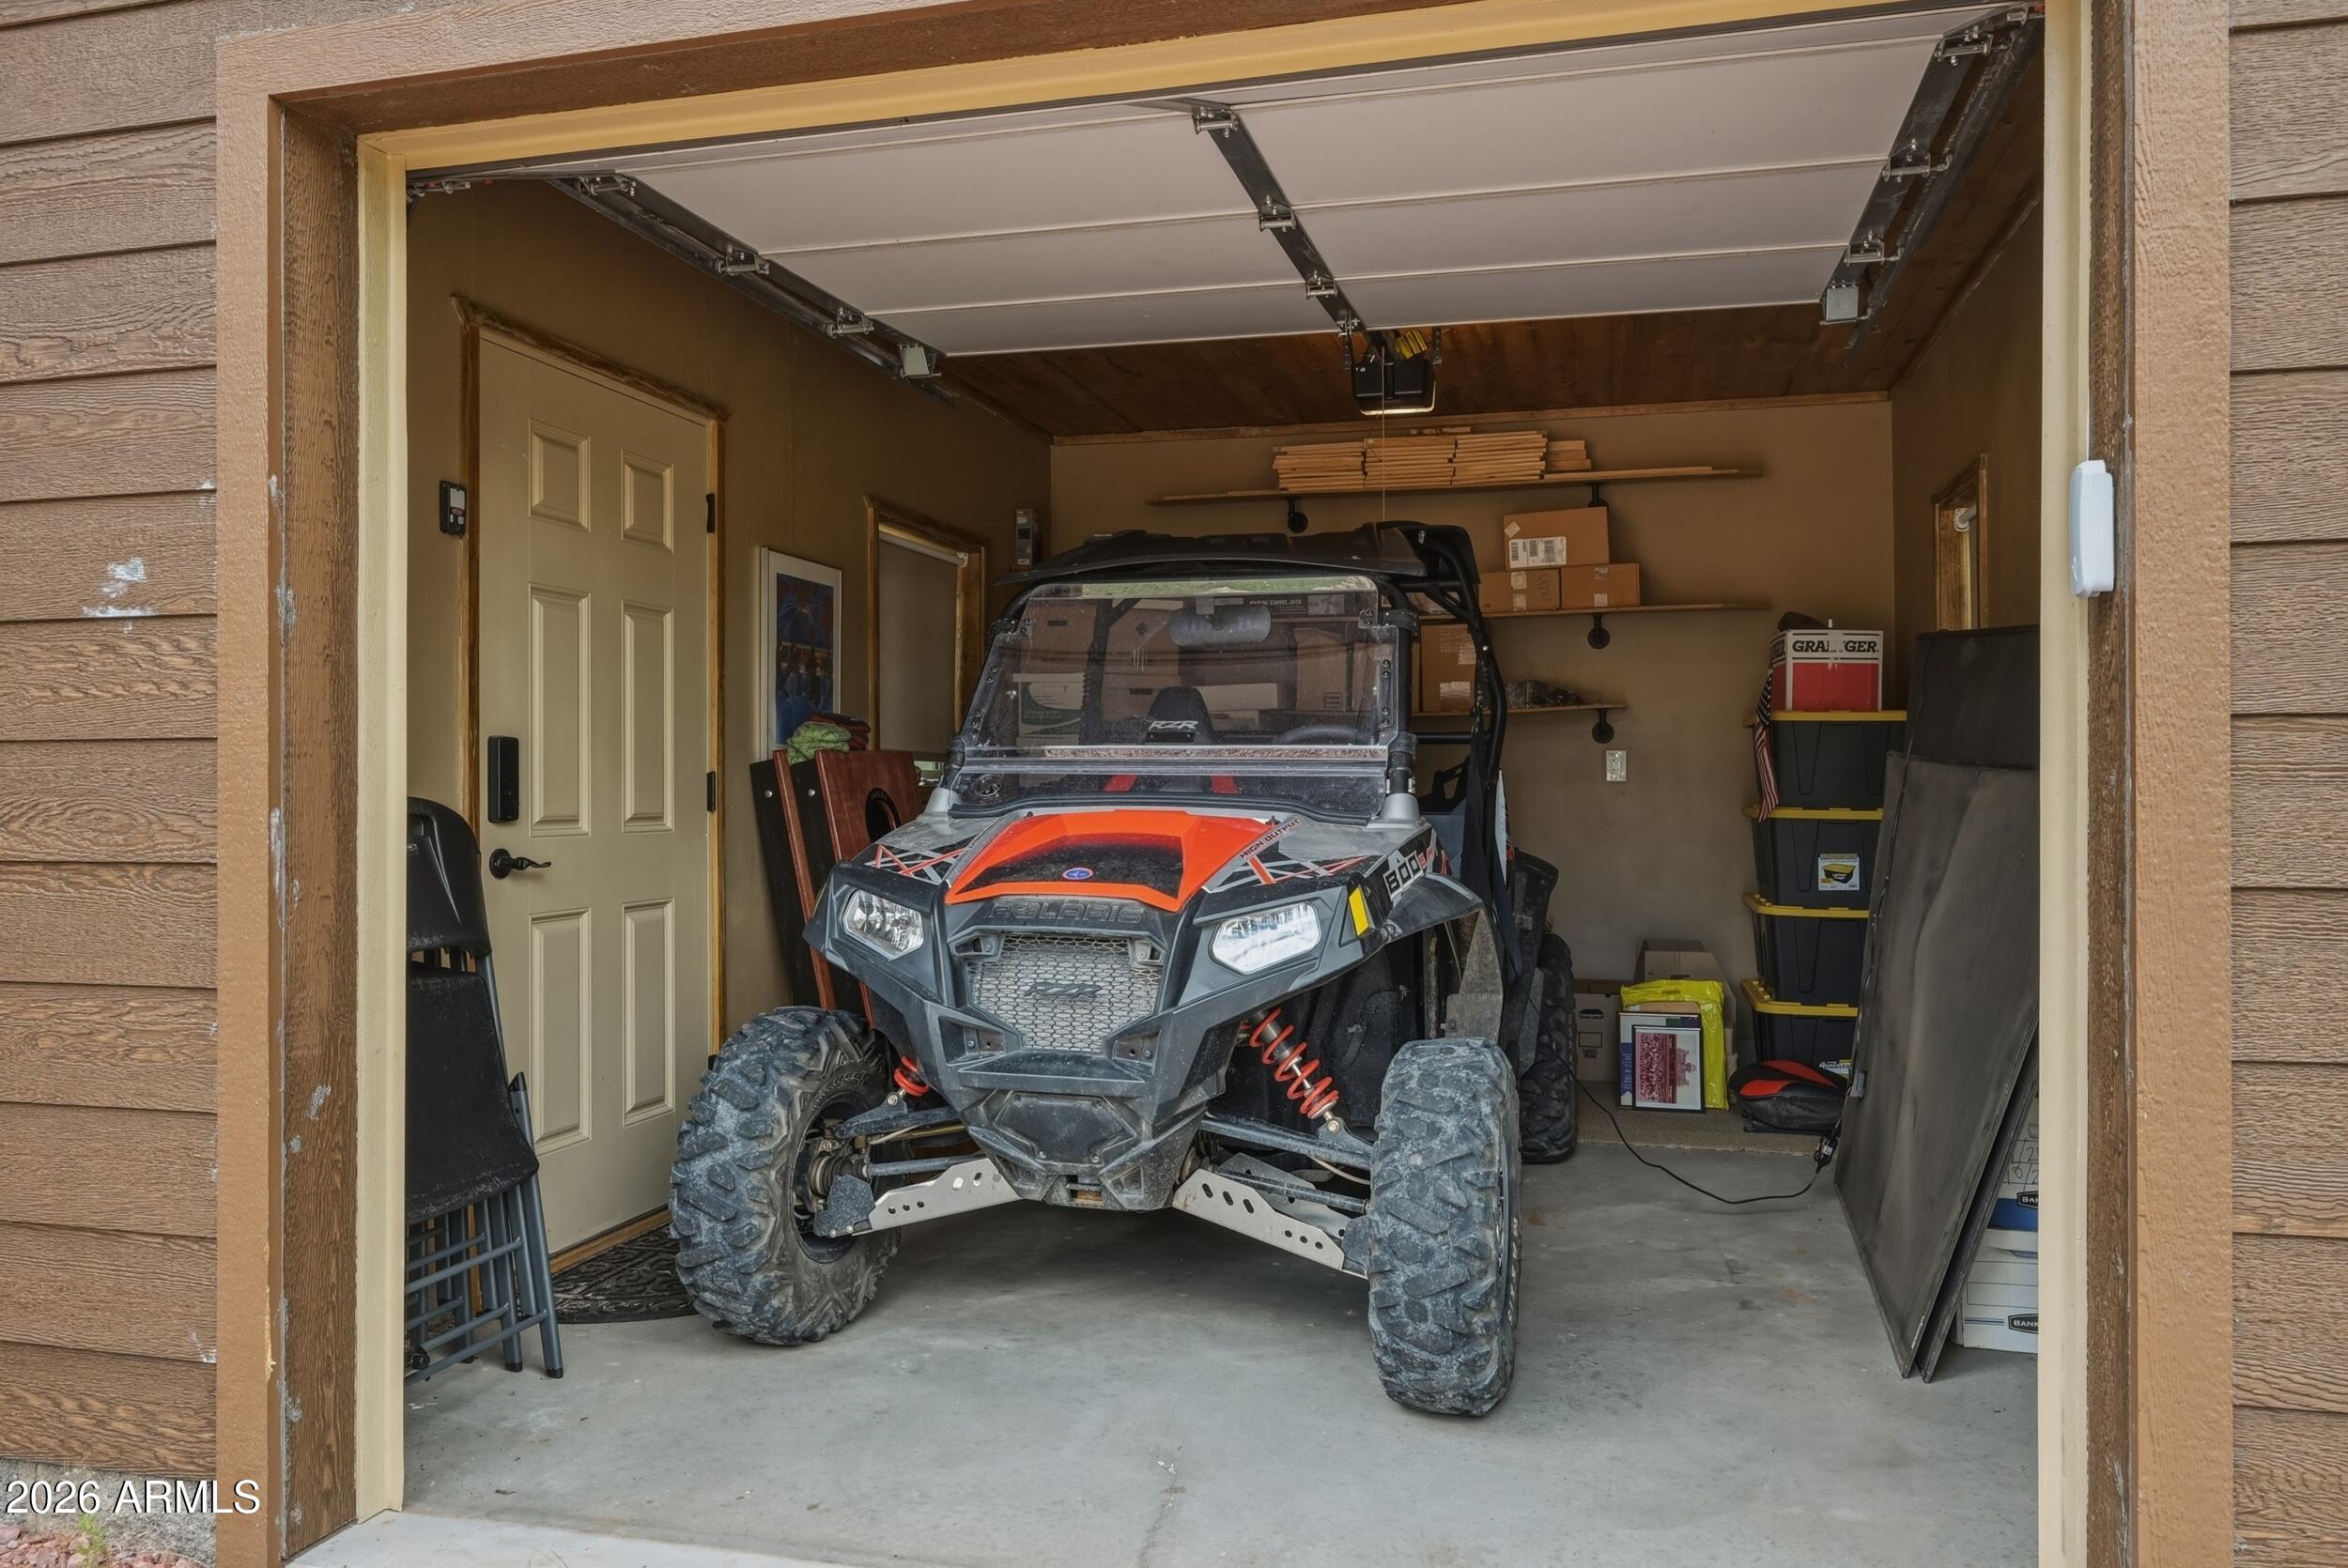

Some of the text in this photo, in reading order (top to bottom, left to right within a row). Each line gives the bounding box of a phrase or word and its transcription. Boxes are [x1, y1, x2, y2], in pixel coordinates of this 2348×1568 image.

[1148, 720, 1199, 730] RZR
[1239, 818, 1300, 859] HIGH OUTPUT
[1384, 853, 1422, 894] 800
[989, 900, 1145, 924] POLARIS
[1023, 981, 1103, 999] RZR
